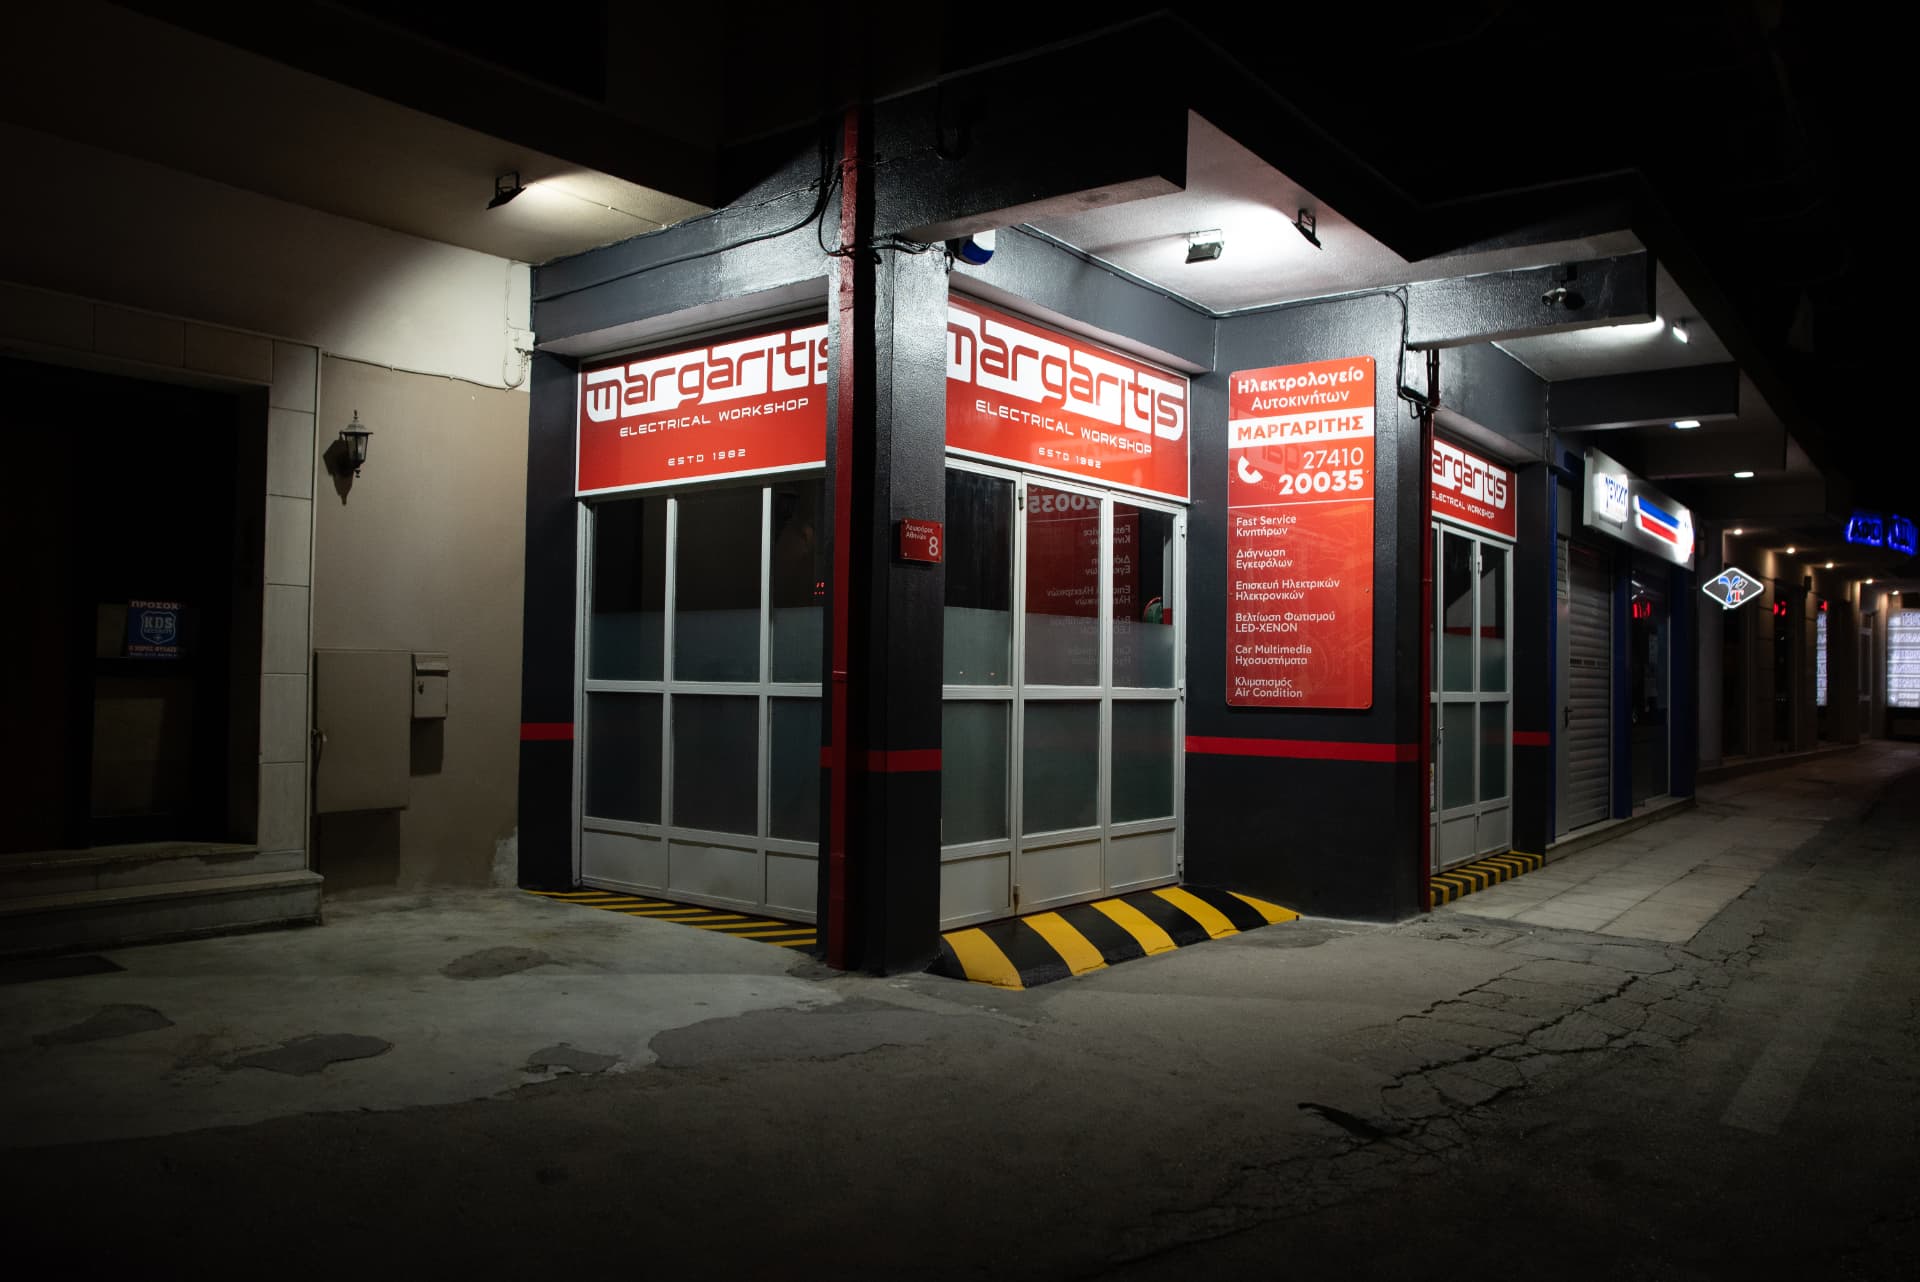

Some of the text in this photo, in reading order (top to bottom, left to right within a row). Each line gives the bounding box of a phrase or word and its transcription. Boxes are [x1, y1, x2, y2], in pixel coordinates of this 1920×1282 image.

[1237, 366, 1364, 395] Ηλεκτρολογείο
[1251, 390, 1350, 411] Αυτοκινήτων
[619, 398, 809, 437] ELECTRICAL WORKSHOP
[975, 399, 1152, 454] ELECTRICAL WORKSHOP
[1237, 415, 1364, 441] ΜΑΡΓΑΡΙΤΗΣ
[667, 449, 746, 466] ESTD 1982
[1038, 447, 1102, 468] ESTD 1982
[1303, 447, 1364, 470] 27410
[1432, 440, 1508, 509] argaritis
[1279, 469, 1364, 495] 20035
[1236, 515, 1296, 526] Fast Service
[1236, 526, 1288, 537] Κινητήρων
[928, 536, 938, 556] 8
[1236, 548, 1286, 560] Διάγνωση
[1236, 558, 1293, 570] Εγκεφάλων
[1235, 577, 1340, 591] Επισκευή Ηλεκτρικών
[1235, 591, 1304, 602] Ηλεκτρονικών
[144, 616, 173, 628] KDS
[1235, 611, 1336, 623] Βελτίωση Φωτισμού
[1235, 622, 1298, 633] LED-XENON
[1235, 644, 1312, 654] Car Multimedia
[1235, 655, 1308, 667] Ηχοσυστήματα
[1235, 677, 1292, 688] Κλιματισμός
[1235, 687, 1303, 698] Air Condition
